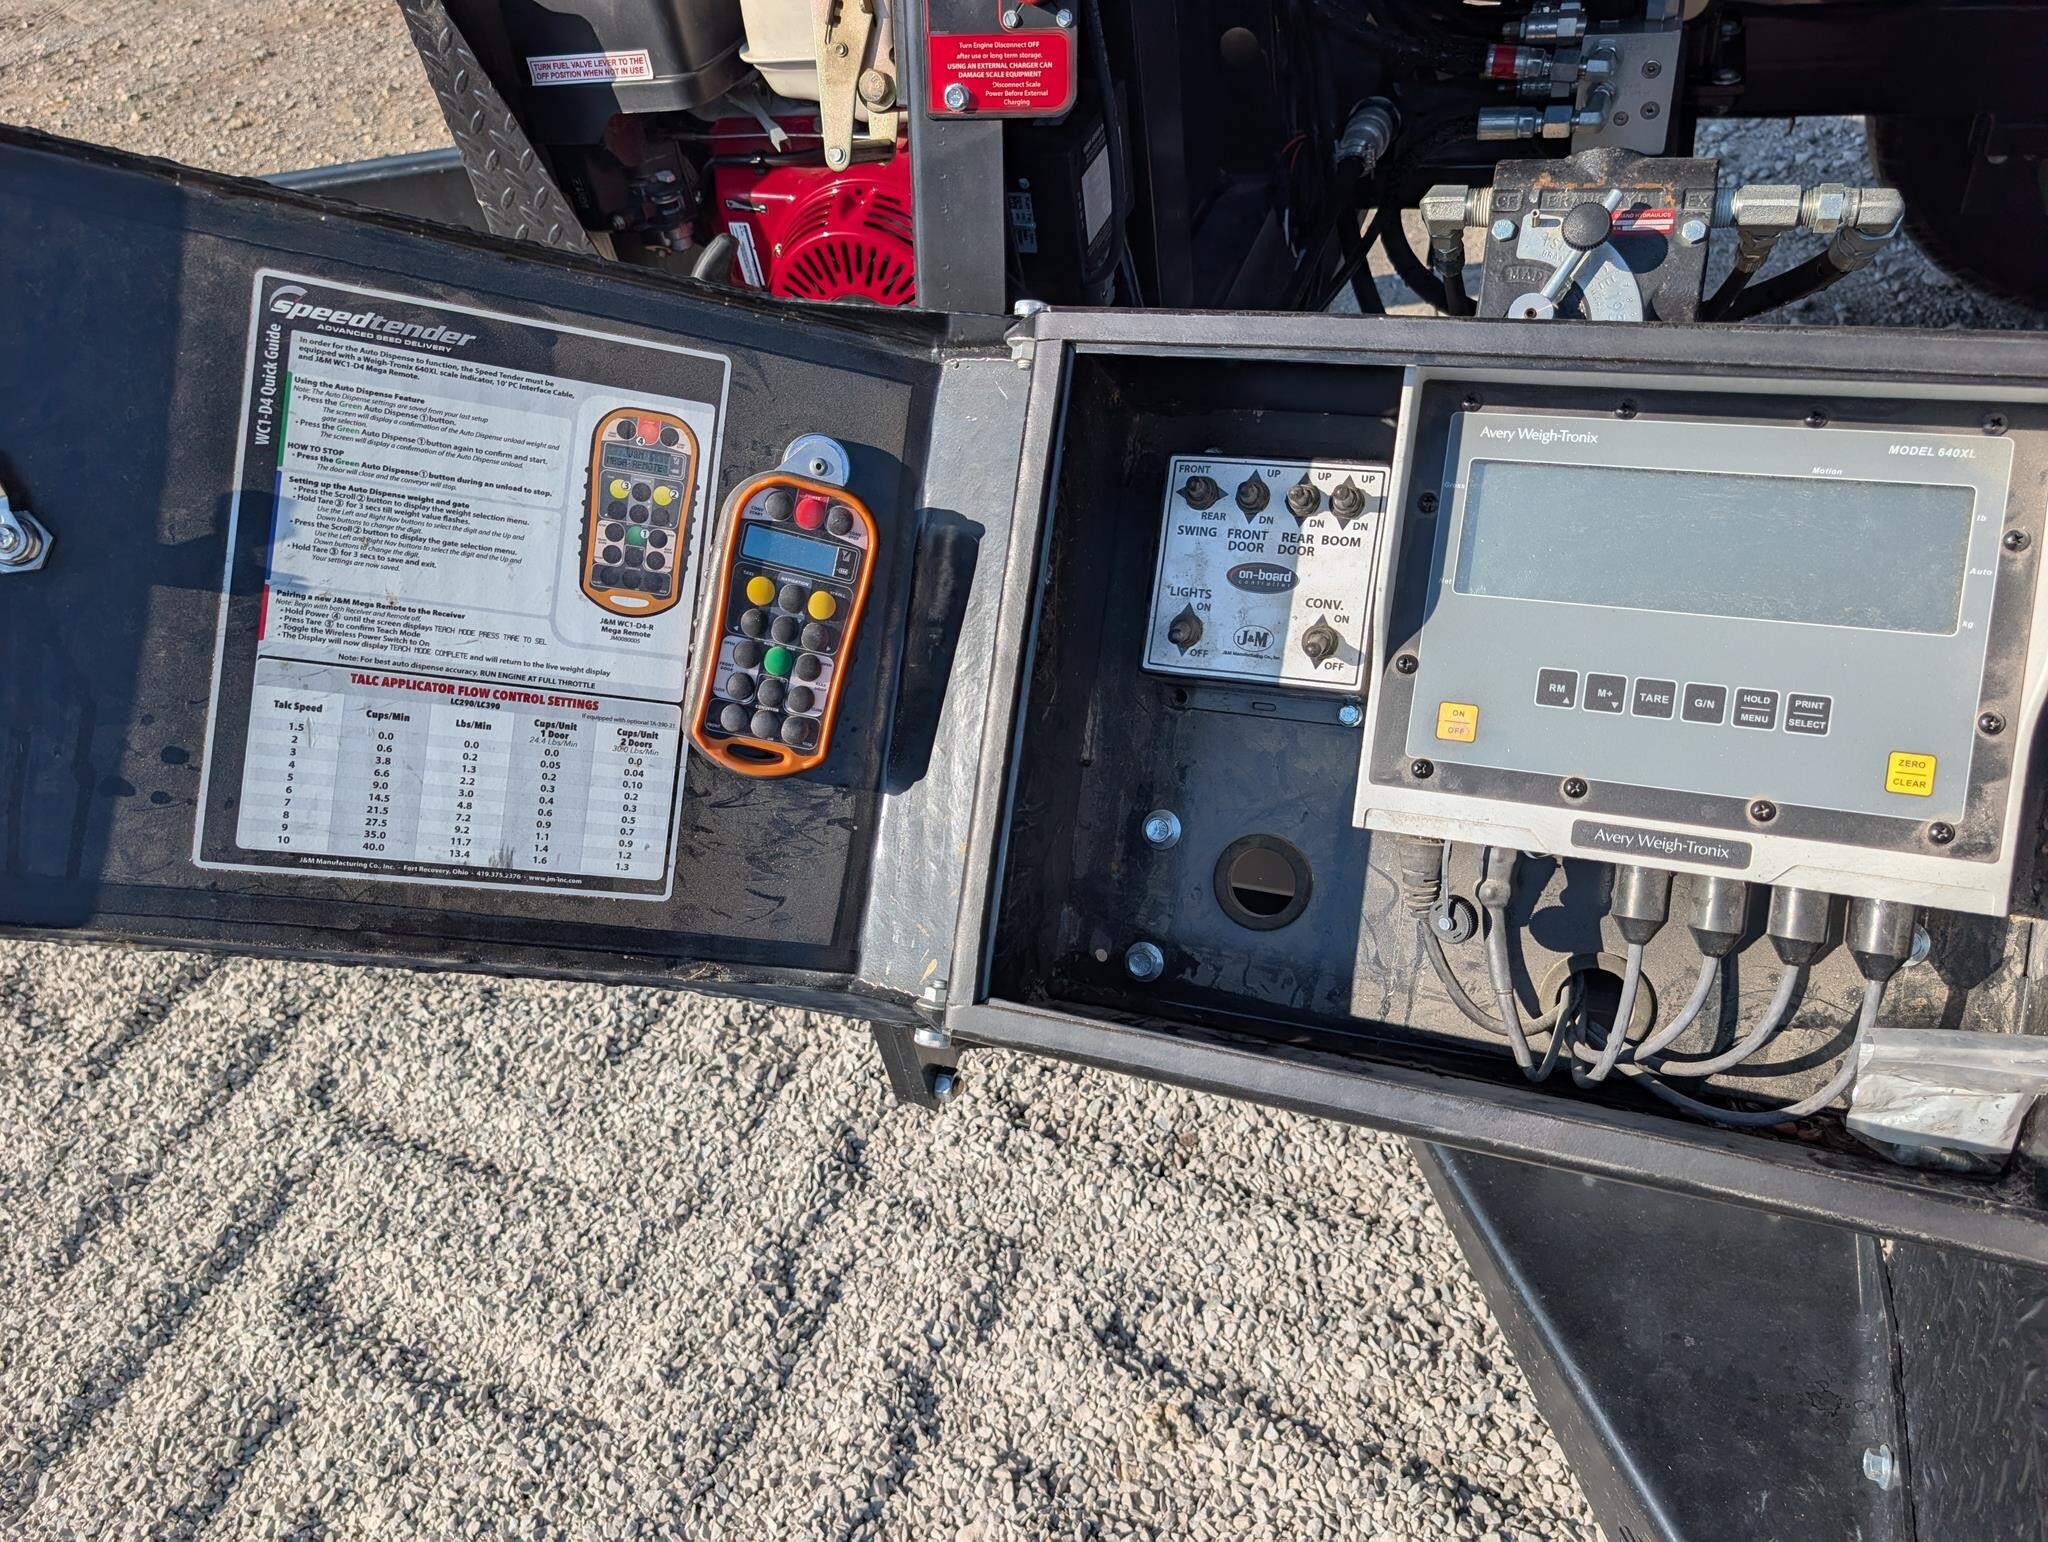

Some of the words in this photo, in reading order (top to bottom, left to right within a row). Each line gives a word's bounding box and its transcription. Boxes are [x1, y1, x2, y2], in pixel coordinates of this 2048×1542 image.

[973, 42, 993, 50] Engine
[534, 62, 552, 71] TURN
[553, 61, 569, 70] FUEL
[571, 59, 593, 69] VALVE
[594, 57, 617, 67] LEVER
[619, 57, 628, 66] TO
[629, 56, 644, 65] THE
[536, 72, 550, 80] OFF
[551, 70, 581, 79] POSITION
[583, 68, 603, 77] WHEN
[605, 68, 619, 76] NOT
[621, 67, 628, 75] IN
[630, 66, 644, 74] USE
[264, 323, 281, 360] Guide
[317, 324, 374, 340] ADVANCED
[376, 333, 402, 344] SEED
[404, 338, 453, 353] DELIVERY
[260, 361, 278, 396] Quick
[294, 376, 318, 387] Using
[319, 381, 334, 389] the
[334, 384, 354, 393] Auto
[356, 387, 393, 400] Dispense
[394, 393, 425, 404] Feature
[255, 398, 274, 445] WC1-D4
[1480, 426, 1516, 443] Avery
[1517, 427, 1599, 445] Weigh-Tronix
[287, 441, 308, 451] HOW
[310, 445, 321, 453] TO
[322, 447, 344, 457] STOP
[1888, 445, 1935, 457] MODEL
[1938, 447, 1977, 459] 640XL
[1178, 464, 1211, 474] FRONT
[1267, 469, 1281, 478] UP
[1812, 467, 1843, 476] Motion
[1318, 472, 1332, 481] UP
[1361, 475, 1376, 484] UP
[1201, 512, 1227, 522] REAR
[1259, 515, 1274, 525] DN
[1309, 519, 1325, 529] DN
[1353, 522, 1368, 531] DN
[1177, 525, 1217, 538] SWING
[1227, 528, 1269, 541] FRONT
[1282, 533, 1314, 544] REAR
[1321, 536, 1361, 548] BOOM
[1228, 541, 1264, 554] DOOR
[1278, 544, 1315, 557] DOOR
[1239, 569, 1291, 582] on-board
[1969, 567, 1992, 576] Auto
[1170, 586, 1212, 600] LIGHTS
[1197, 603, 1211, 612] ON
[1305, 598, 1343, 611] CONV.
[600, 617, 616, 626] J&M
[618, 619, 654, 632] WC1-D4-R
[1334, 615, 1350, 624] ON
[601, 626, 621, 637] Mega
[623, 628, 651, 639] Remote
[1237, 630, 1270, 648] J&M
[1190, 649, 1208, 658] OFF
[1325, 662, 1344, 672] OFF
[350, 673, 379, 686] TALC
[381, 676, 455, 694] APPLICATOR
[458, 686, 491, 698] FLOW
[493, 688, 546, 706] CONTROL
[547, 695, 600, 711] SETTINGS
[1549, 683, 1566, 694] RM
[1597, 688, 1613, 698] M+
[450, 697, 501, 710] LC290/LC390
[1640, 693, 1670, 705] TARE
[1694, 698, 1715, 709] G/N
[1744, 694, 1771, 705] HOLD
[274, 700, 292, 710] Talc
[294, 702, 322, 714] Speed
[1795, 700, 1825, 711] PRINT
[366, 710, 410, 723] Cups/Min
[1740, 713, 1769, 724] MENU
[288, 722, 304, 732] 1.5
[455, 719, 492, 731] Lbs/Min
[534, 719, 578, 732] Cups/Unit
[1788, 718, 1826, 730] SELECT
[378, 732, 394, 741] 0.0
[541, 730, 546, 738] 1
[548, 731, 569, 740] Door
[617, 728, 659, 740] Cups/Unit
[1448, 727, 1465, 735] OFF
[377, 744, 393, 753] 0.6
[620, 739, 627, 748] 2
[628, 740, 653, 749] Doors
[290, 748, 296, 756] 3
[288, 761, 295, 769] 4
[375, 756, 391, 765] 3.8
[1898, 760, 1926, 769] ZERO
[287, 773, 294, 781] 5
[374, 769, 390, 778] 6.6
[372, 781, 389, 790] 9.0
[1893, 778, 1927, 789] CLEAR
[285, 786, 293, 794] 6
[369, 793, 390, 803] 14.5
[283, 811, 290, 819] 8
[367, 806, 389, 815] 21.5
[281, 823, 288, 832] 9
[365, 818, 388, 828] 27.5
[278, 836, 290, 844] 10
[364, 831, 386, 840] 35.0
[362, 843, 385, 852] 40.0
[1594, 829, 1634, 847] Avery
[1638, 833, 1730, 859] Weigh-Tronix
[299, 857, 315, 865] J&M
[315, 858, 368, 870] Manufacturing
[369, 862, 381, 871] Co.,
[383, 863, 395, 871] Inc.
[529, 874, 582, 885] www.jm-inc.com
